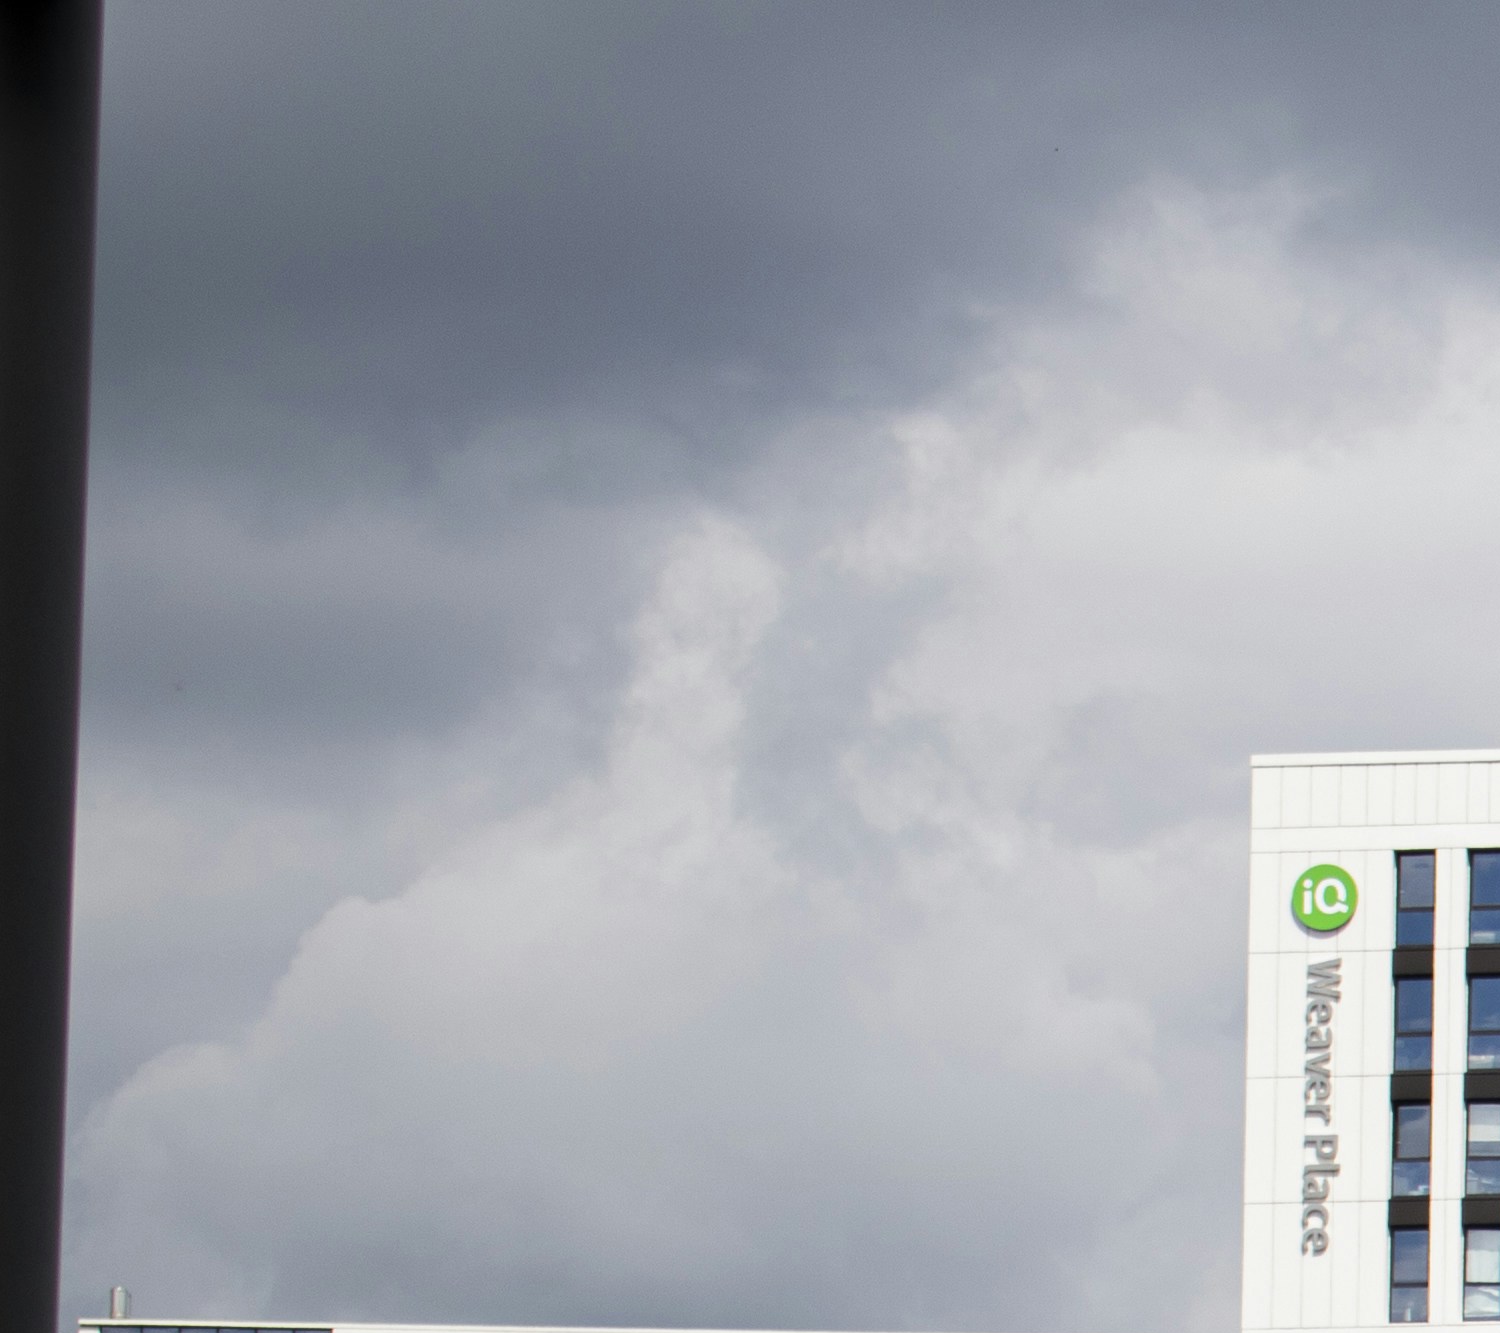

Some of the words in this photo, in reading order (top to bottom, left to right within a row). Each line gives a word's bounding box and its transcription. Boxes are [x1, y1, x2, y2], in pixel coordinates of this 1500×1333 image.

[1303, 878, 1349, 915] iQ
[1303, 957, 1342, 1127] Weaver
[1300, 1134, 1341, 1257] Place
